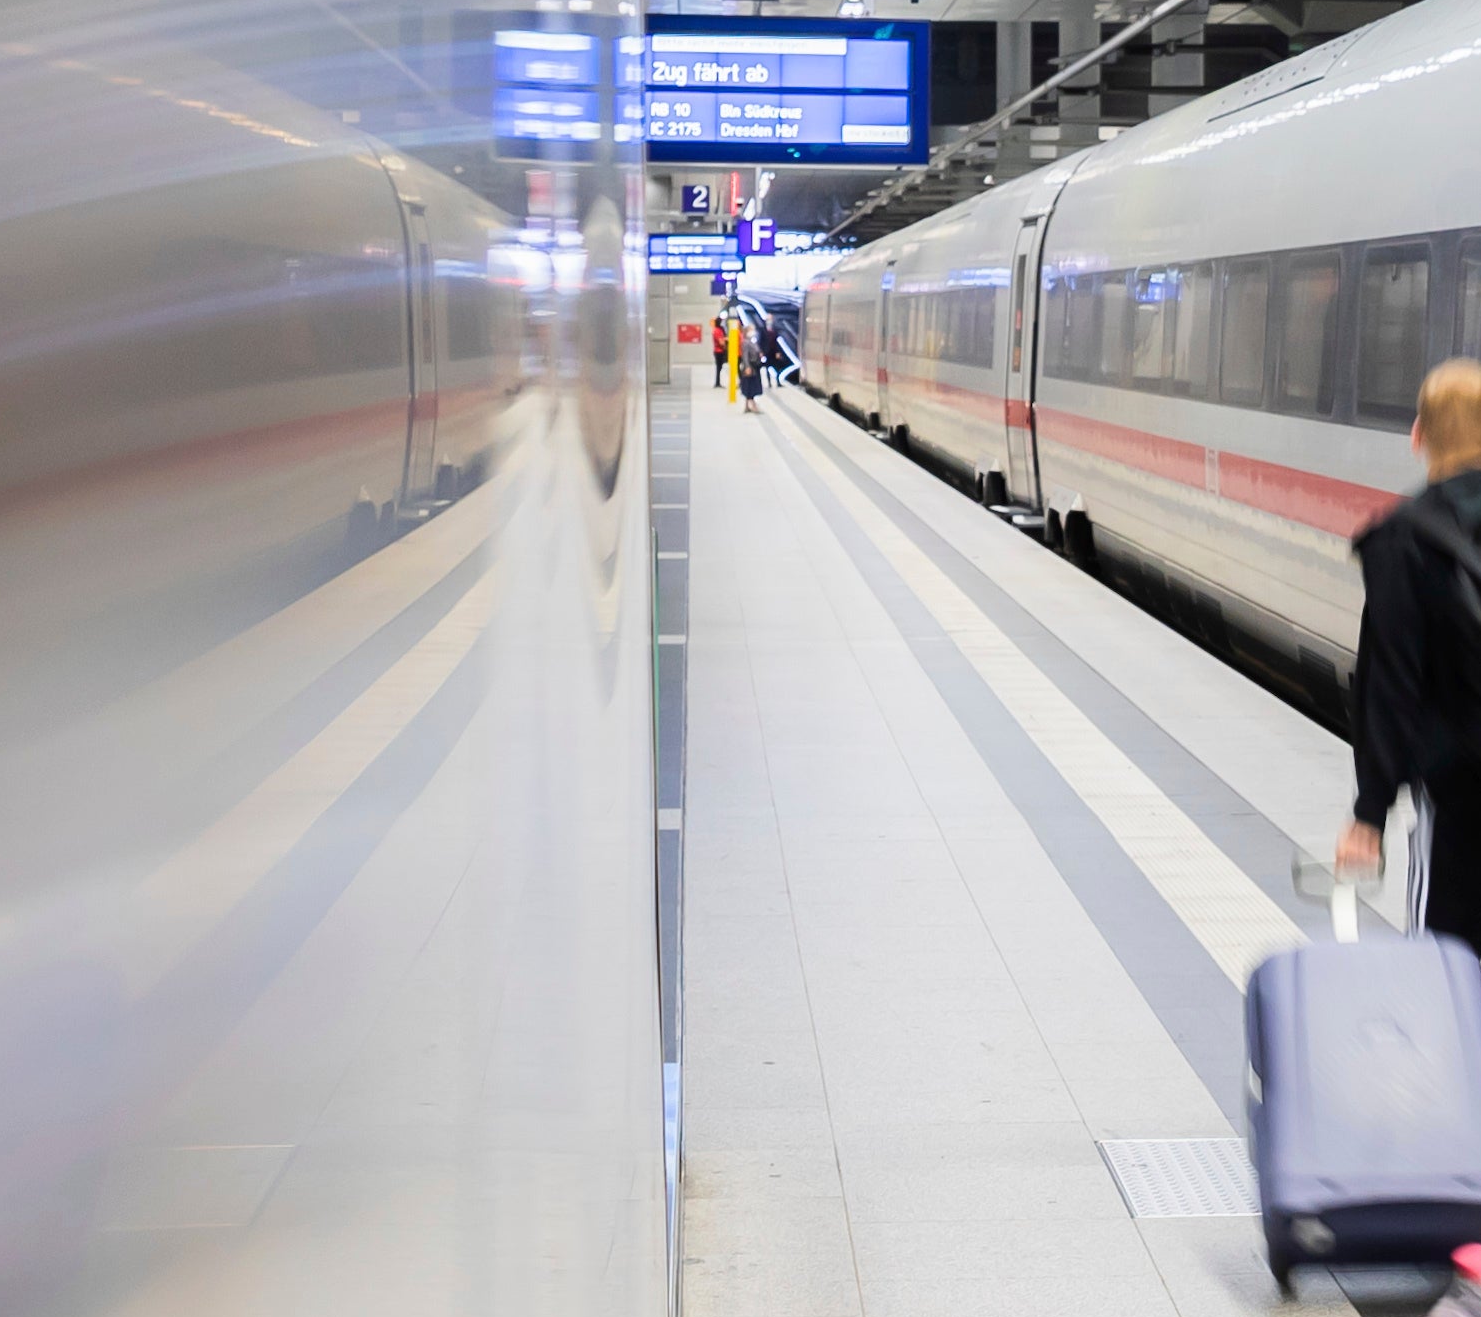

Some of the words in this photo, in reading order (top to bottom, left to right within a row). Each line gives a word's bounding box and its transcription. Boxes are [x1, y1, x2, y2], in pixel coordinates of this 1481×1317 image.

[652, 61, 688, 86] Zug
[693, 62, 740, 83] fährt
[745, 63, 769, 83] ab
[691, 185, 708, 209] 2
[751, 218, 773, 252] F
